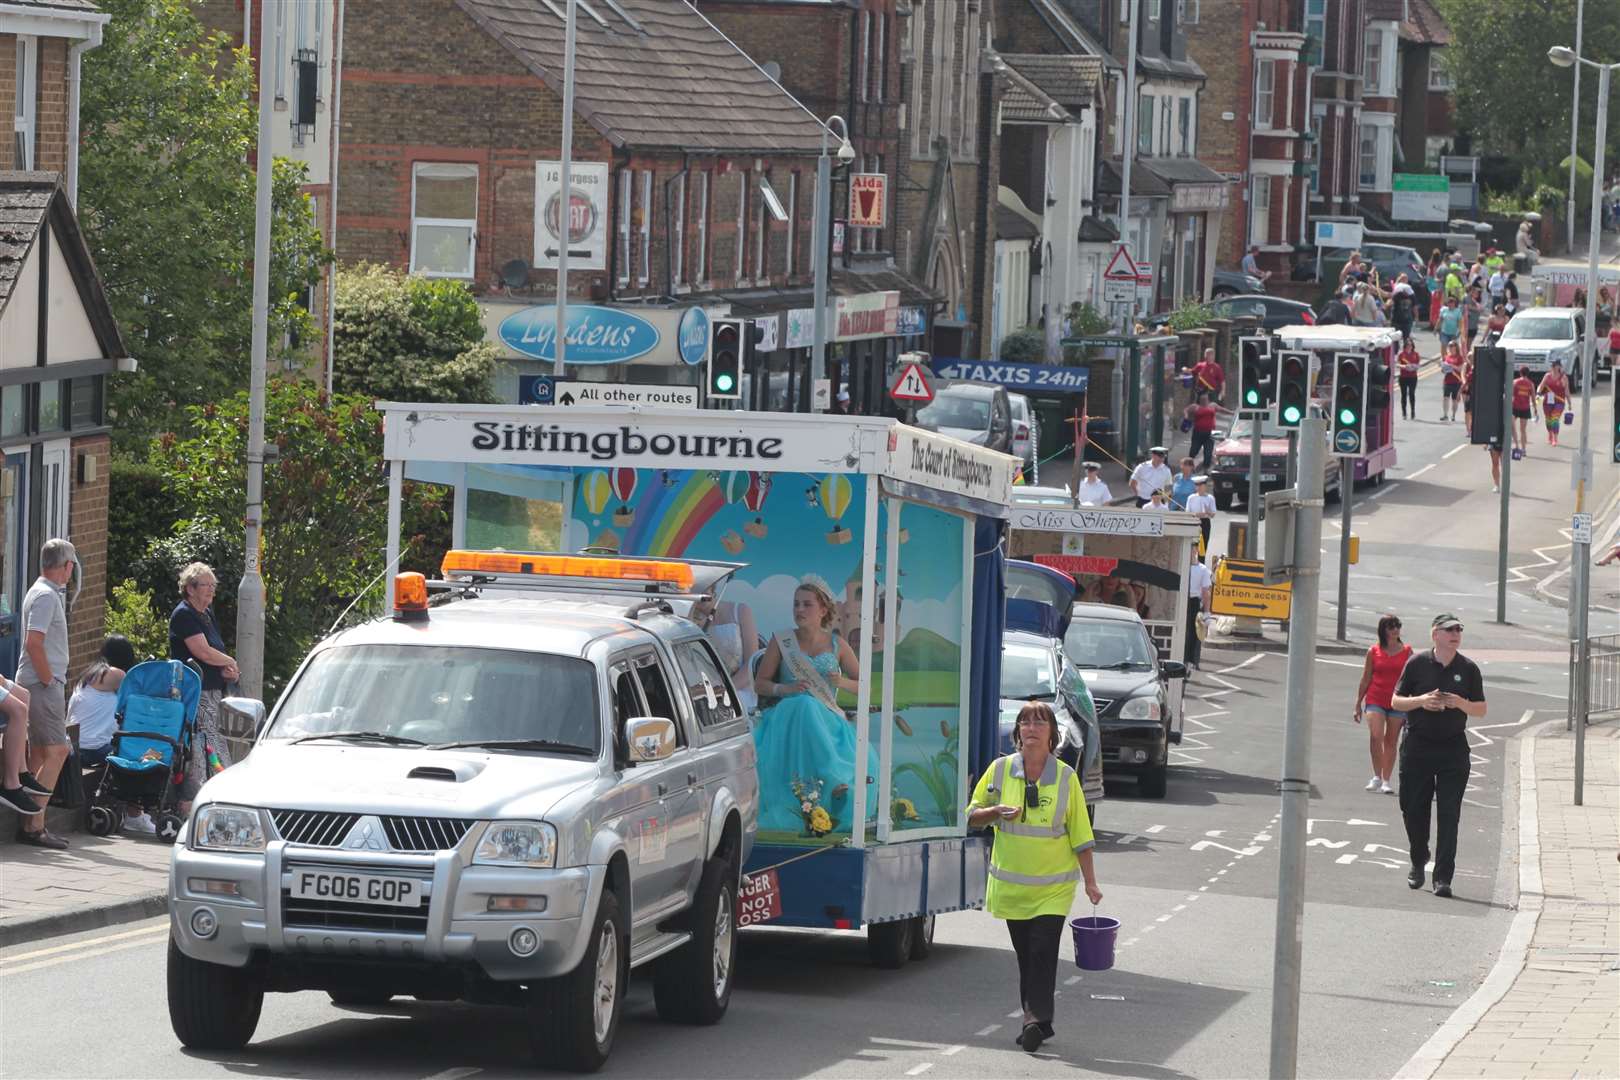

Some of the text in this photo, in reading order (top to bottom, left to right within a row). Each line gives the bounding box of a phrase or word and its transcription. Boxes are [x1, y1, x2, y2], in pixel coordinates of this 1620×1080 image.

[569, 174, 598, 185] rgess
[852, 177, 882, 188] Aida
[957, 363, 1088, 386] TAXIS 24hr
[580, 388, 692, 404] All other routes
[472, 421, 783, 460] Sittingbourne
[911, 438, 925, 472] The
[925, 441, 943, 476] Court
[943, 446, 952, 478] of
[1019, 511, 1142, 533] Miss Sheppey
[1215, 586, 1288, 601] Station access
[300, 873, 412, 902] FG06 GOP
[742, 893, 774, 913] NOT
[739, 907, 771, 926] OSS
